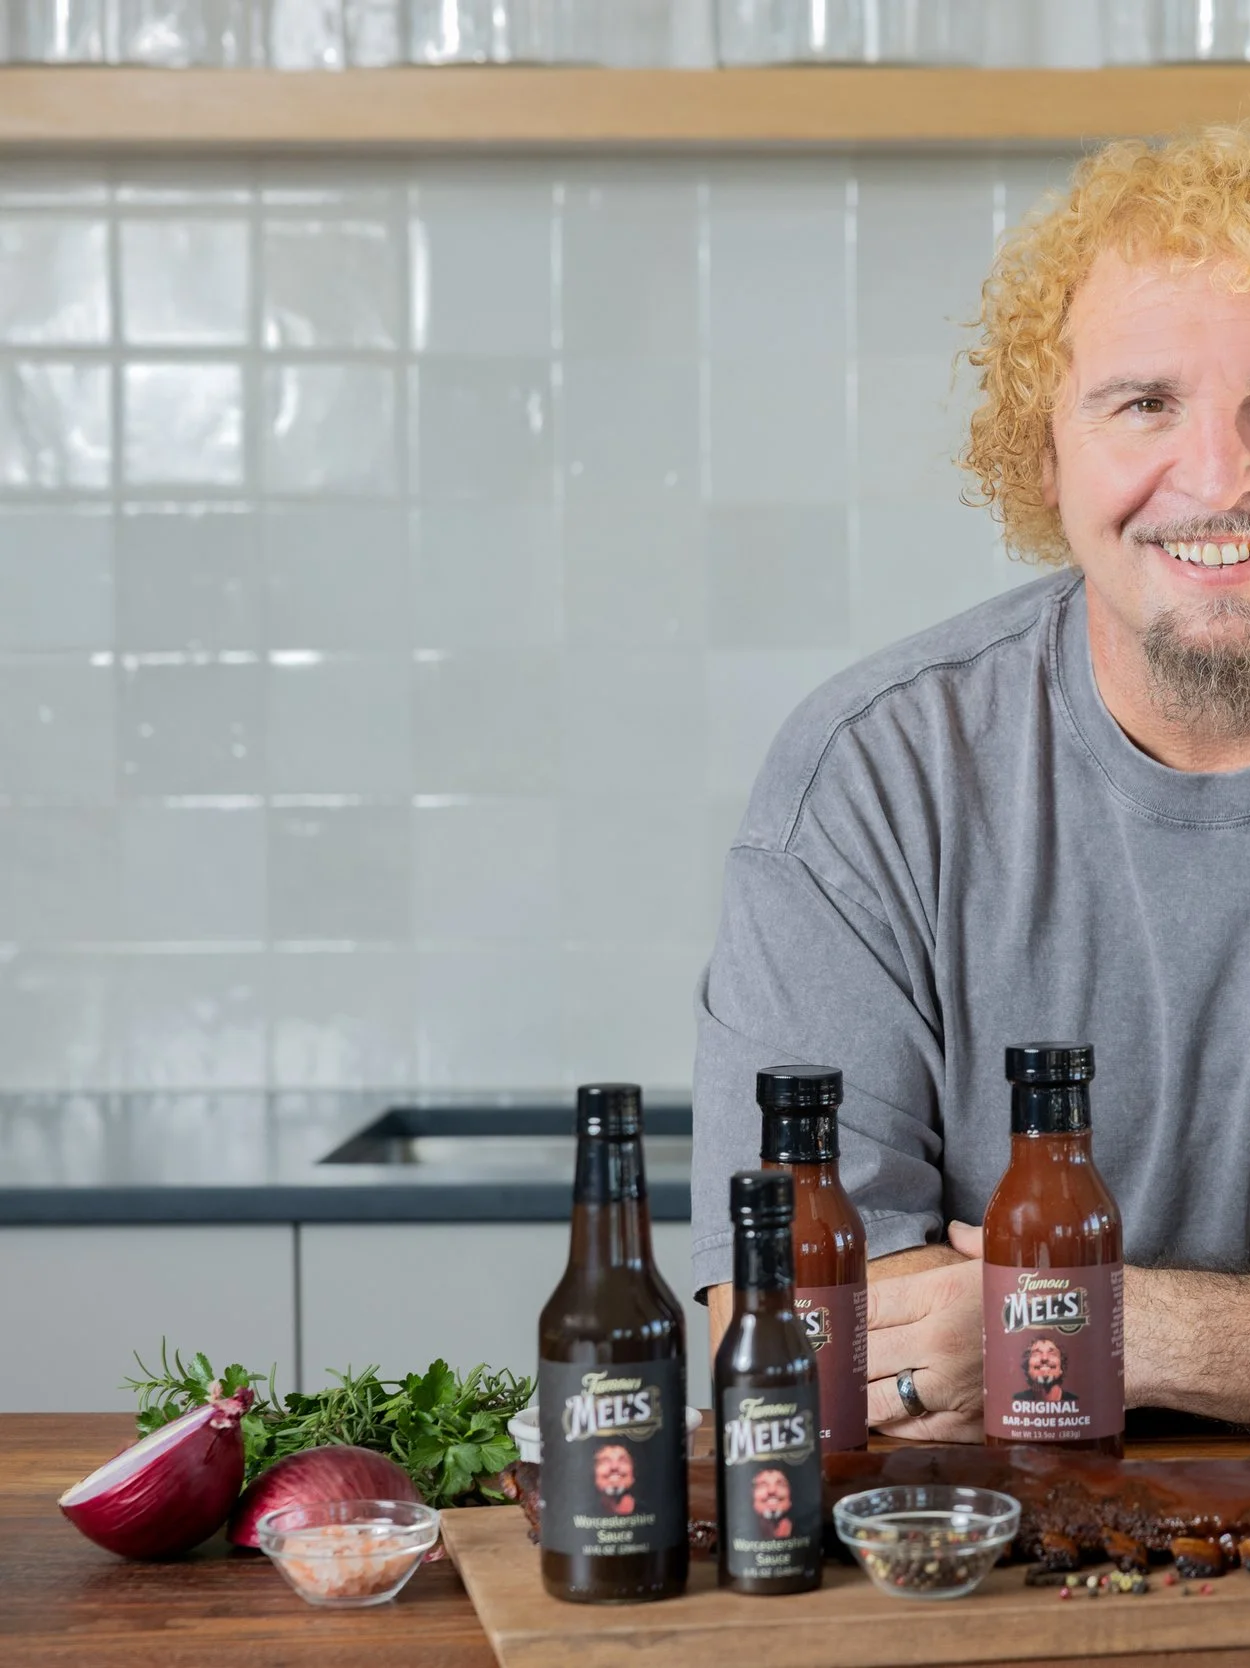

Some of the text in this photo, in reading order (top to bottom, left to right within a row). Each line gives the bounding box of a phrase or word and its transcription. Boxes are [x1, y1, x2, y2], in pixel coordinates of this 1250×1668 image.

[1017, 1271, 1070, 1293] Famous
[1004, 1291, 1079, 1334] MEL'S
[581, 1370, 642, 1396] Famous
[1012, 1400, 1079, 1414] ORIGINAL
[565, 1391, 651, 1442] MEL'S
[1002, 1415, 1090, 1427] BAR-B-QUE SAUCE
[725, 1415, 805, 1466] MEL'S
[1011, 1430, 1022, 1438] Net
[1022, 1431, 1032, 1439] Wt
[597, 1529, 633, 1543] Sauce
[755, 1552, 791, 1566] Sauce
